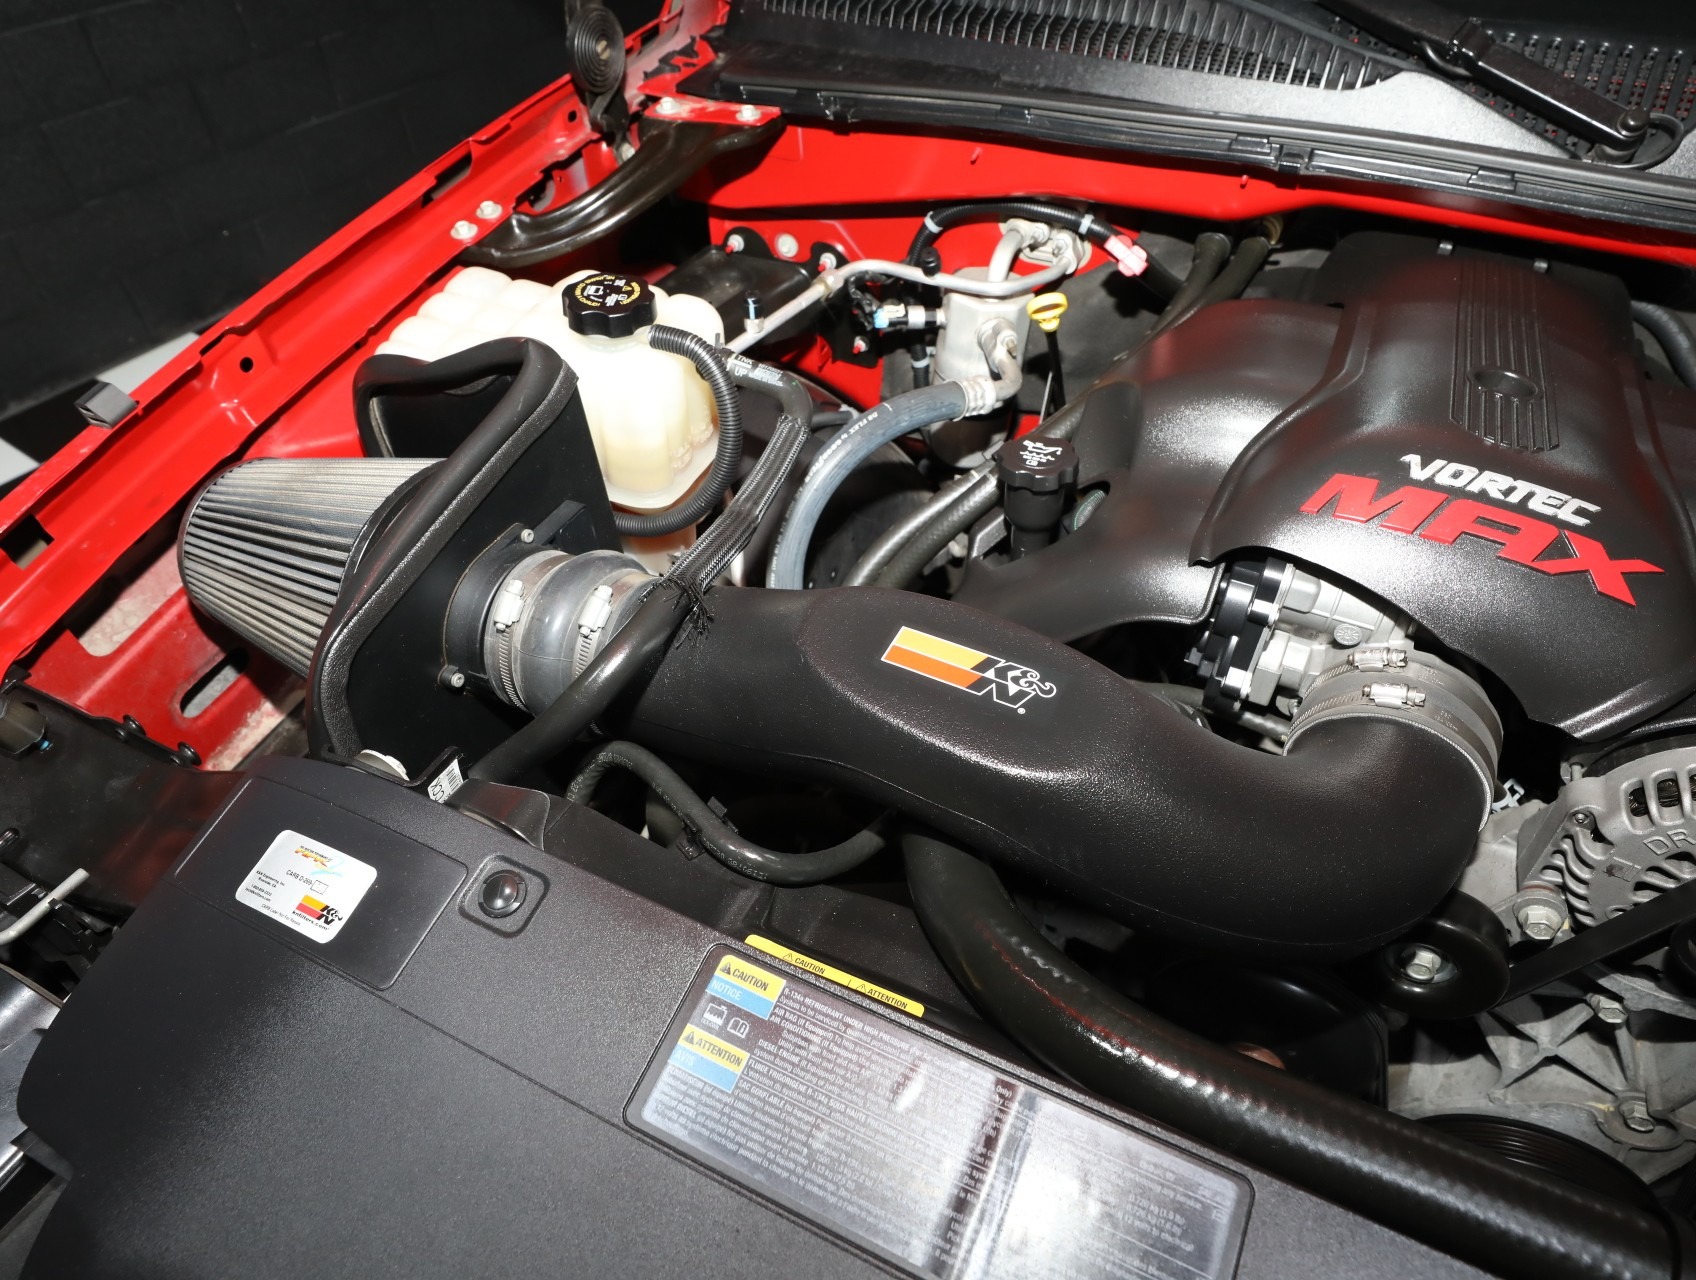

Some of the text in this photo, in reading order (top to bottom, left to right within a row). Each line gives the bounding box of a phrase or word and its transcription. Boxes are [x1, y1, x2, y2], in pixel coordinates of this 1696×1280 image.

[734, 366, 748, 377] UP
[850, 418, 868, 435] FLEX
[1399, 453, 1602, 527] VORTEC
[1299, 473, 1665, 608] MAX
[315, 904, 343, 926] K&N
[710, 979, 743, 1000] NOTICE
[730, 967, 770, 991] CAUTION
[794, 956, 908, 1010] CAUTION ATTENTION
[773, 1006, 785, 1017] AIR
[784, 1011, 798, 1023] BAG
[804, 1021, 834, 1040] Equipped)
[833, 1034, 843, 1044] To
[778, 996, 800, 1010] System
[798, 1005, 807, 1013] to
[805, 1008, 815, 1017] be
[813, 1012, 839, 1028] serviced
[838, 1023, 847, 1032] by
[694, 1037, 743, 1067] ATTENTION
[756, 1038, 778, 1054] DIESEL
[776, 1048, 800, 1065] ENGINE
[769, 1014, 782, 1025] AIR
[779, 1020, 822, 1044] CONDITIONING
[828, 1042, 858, 1061] Equipped)
[782, 988, 804, 1002] R-134a
[803, 997, 843, 1020] REFRIGERANT
[842, 1014, 864, 1029] UNDER
[862, 1024, 879, 1036] HIGH
[878, 1031, 910, 1050] PRESSURE
[994, 1084, 1013, 1098] Only)
[674, 1048, 696, 1066] AVIS
[736, 1079, 751, 1092] SAC
[748, 1085, 785, 1109] GONFLABLE
[747, 1058, 770, 1074] FLUIDE
[806, 1087, 830, 1104] R-134a
[827, 1098, 846, 1112] SOUS
[844, 1106, 867, 1122] HAUTE
